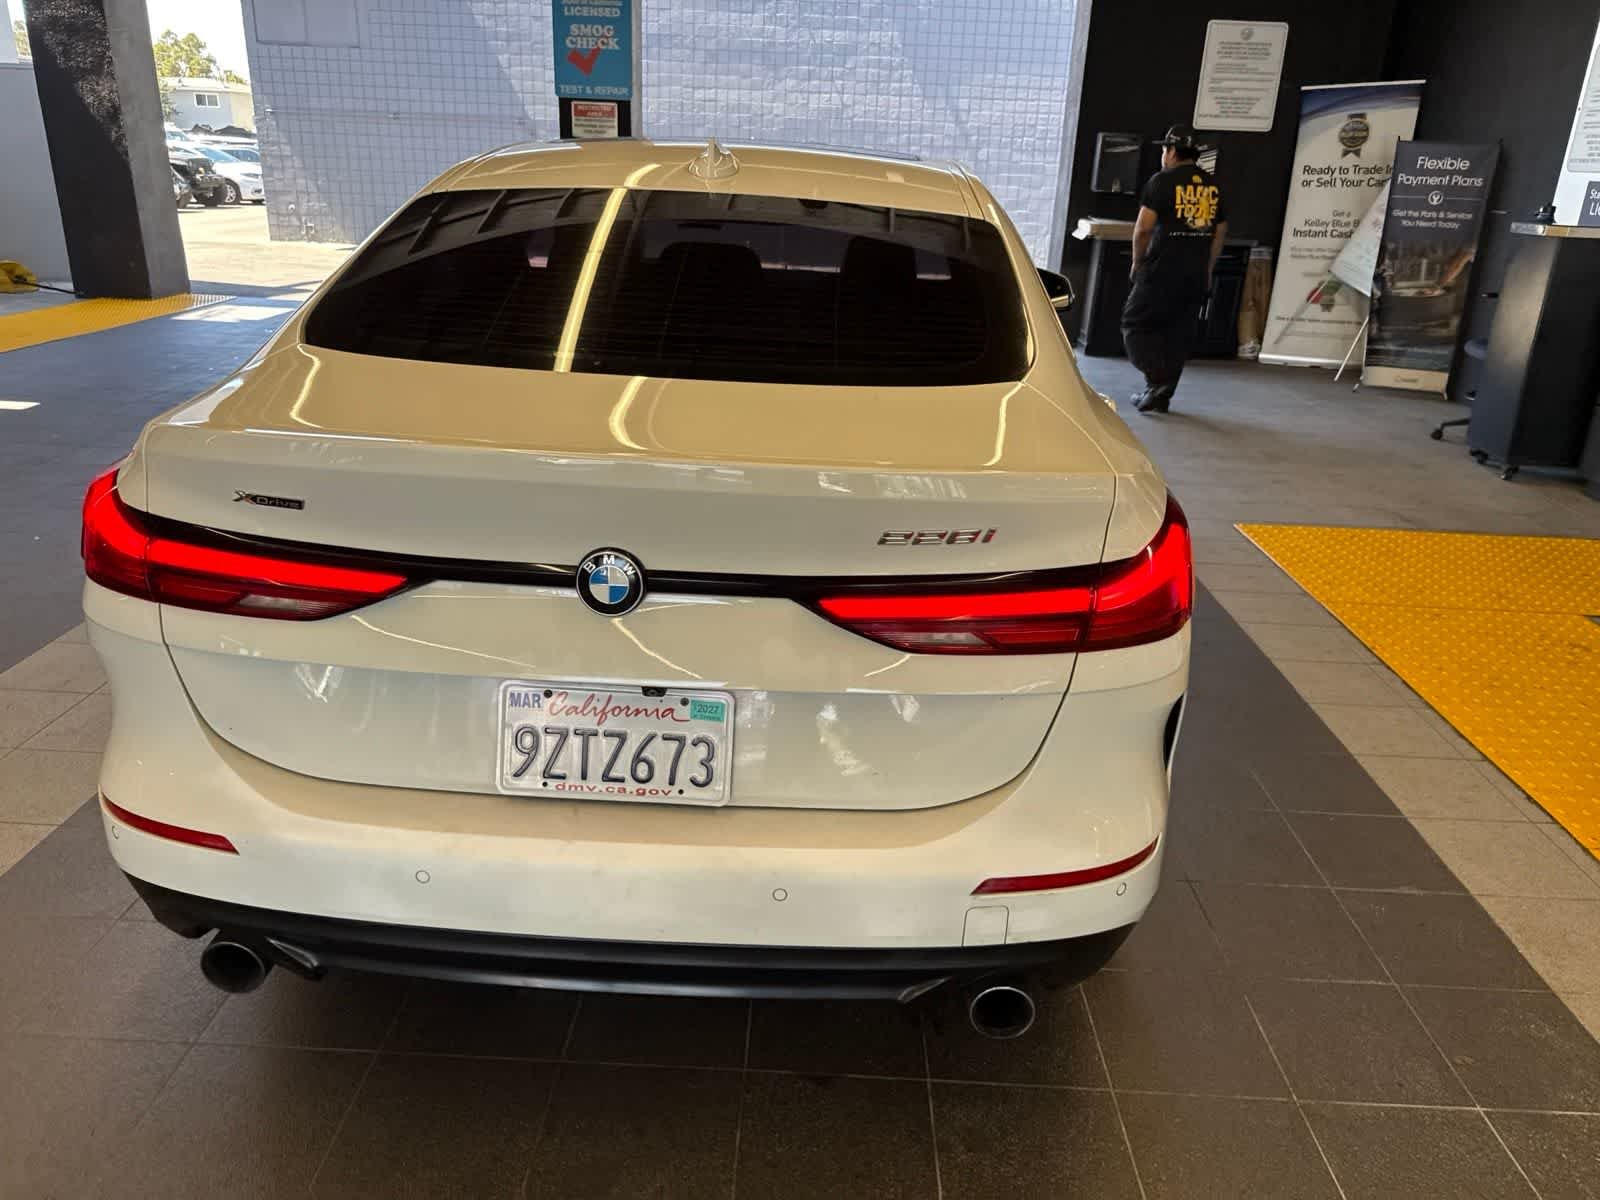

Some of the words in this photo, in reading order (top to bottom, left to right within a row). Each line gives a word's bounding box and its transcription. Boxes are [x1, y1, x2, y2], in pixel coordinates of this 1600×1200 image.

[564, 6, 620, 17] LICENSED
[570, 23, 614, 37] SMOG
[565, 36, 620, 50] CHECK
[559, 85, 583, 95] TEST
[593, 86, 629, 96] REPAIR
[1416, 156, 1471, 170] Flexible
[1302, 164, 1337, 177] Ready
[1339, 165, 1350, 175] to
[1352, 164, 1384, 175] Trade
[1302, 179, 1314, 188] or
[1315, 177, 1337, 188] Sell
[1340, 177, 1365, 188] Your
[1367, 177, 1387, 188] Car
[1397, 173, 1450, 187] Payment
[1451, 175, 1484, 187] Plans
[1175, 204, 1217, 219] TOOS
[1332, 209, 1345, 218] Get
[1392, 209, 1407, 217] Get
[1407, 210, 1419, 218] the
[1420, 210, 1437, 218] Parts
[1446, 211, 1473, 219] Service
[1303, 218, 1331, 229] Kelley
[1331, 218, 1351, 228] Blue
[1401, 219, 1415, 227] You
[1416, 220, 1436, 228] Need
[1438, 220, 1460, 230] Today
[1292, 227, 1328, 239] Instant
[877, 528, 997, 546] 228i
[583, 554, 636, 576] BMW
[509, 692, 544, 709] MAR
[550, 691, 691, 727] California
[697, 703, 720, 714] 2027
[511, 726, 716, 788] 9ZTZ673
[554, 782, 673, 797] dmv.ca.gov
